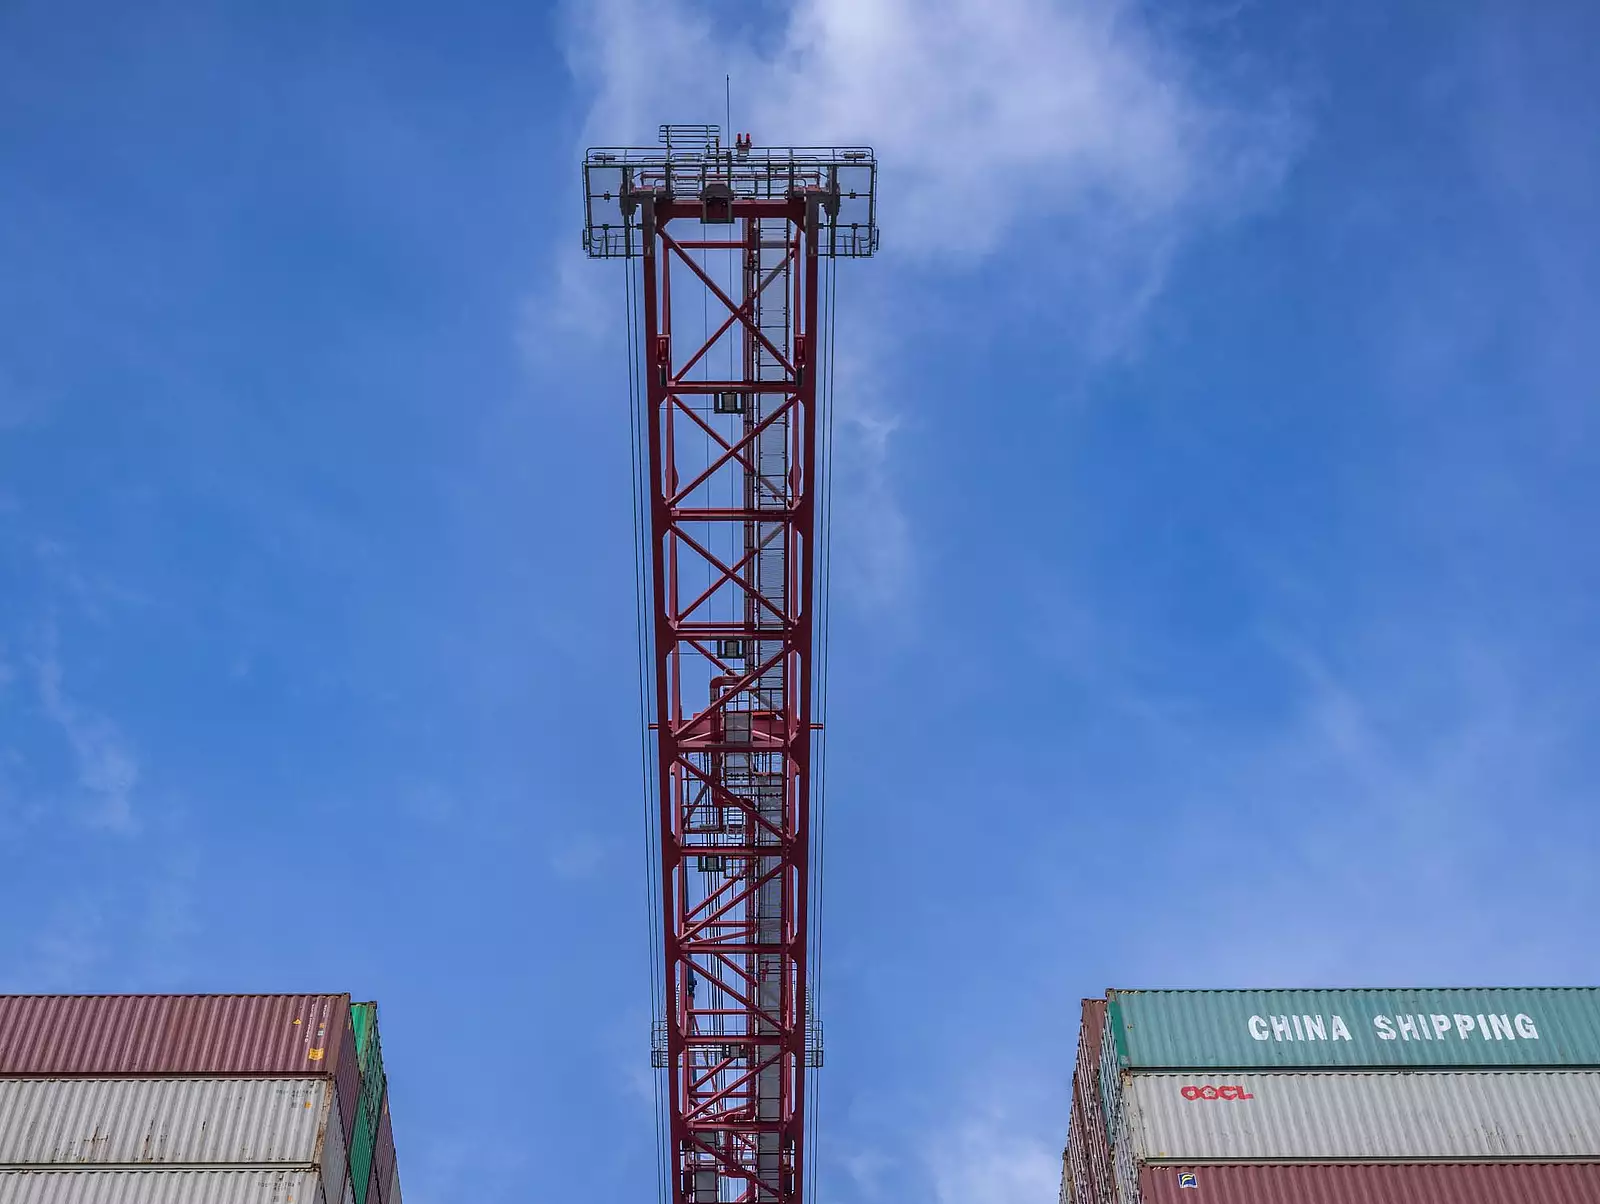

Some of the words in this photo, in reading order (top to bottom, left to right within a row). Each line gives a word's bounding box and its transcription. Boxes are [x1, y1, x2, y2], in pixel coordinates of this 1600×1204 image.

[1248, 1014, 1352, 1042] CHINA
[1373, 1013, 1539, 1041] SHIPPING
[1181, 1085, 1253, 1101] OOCL
